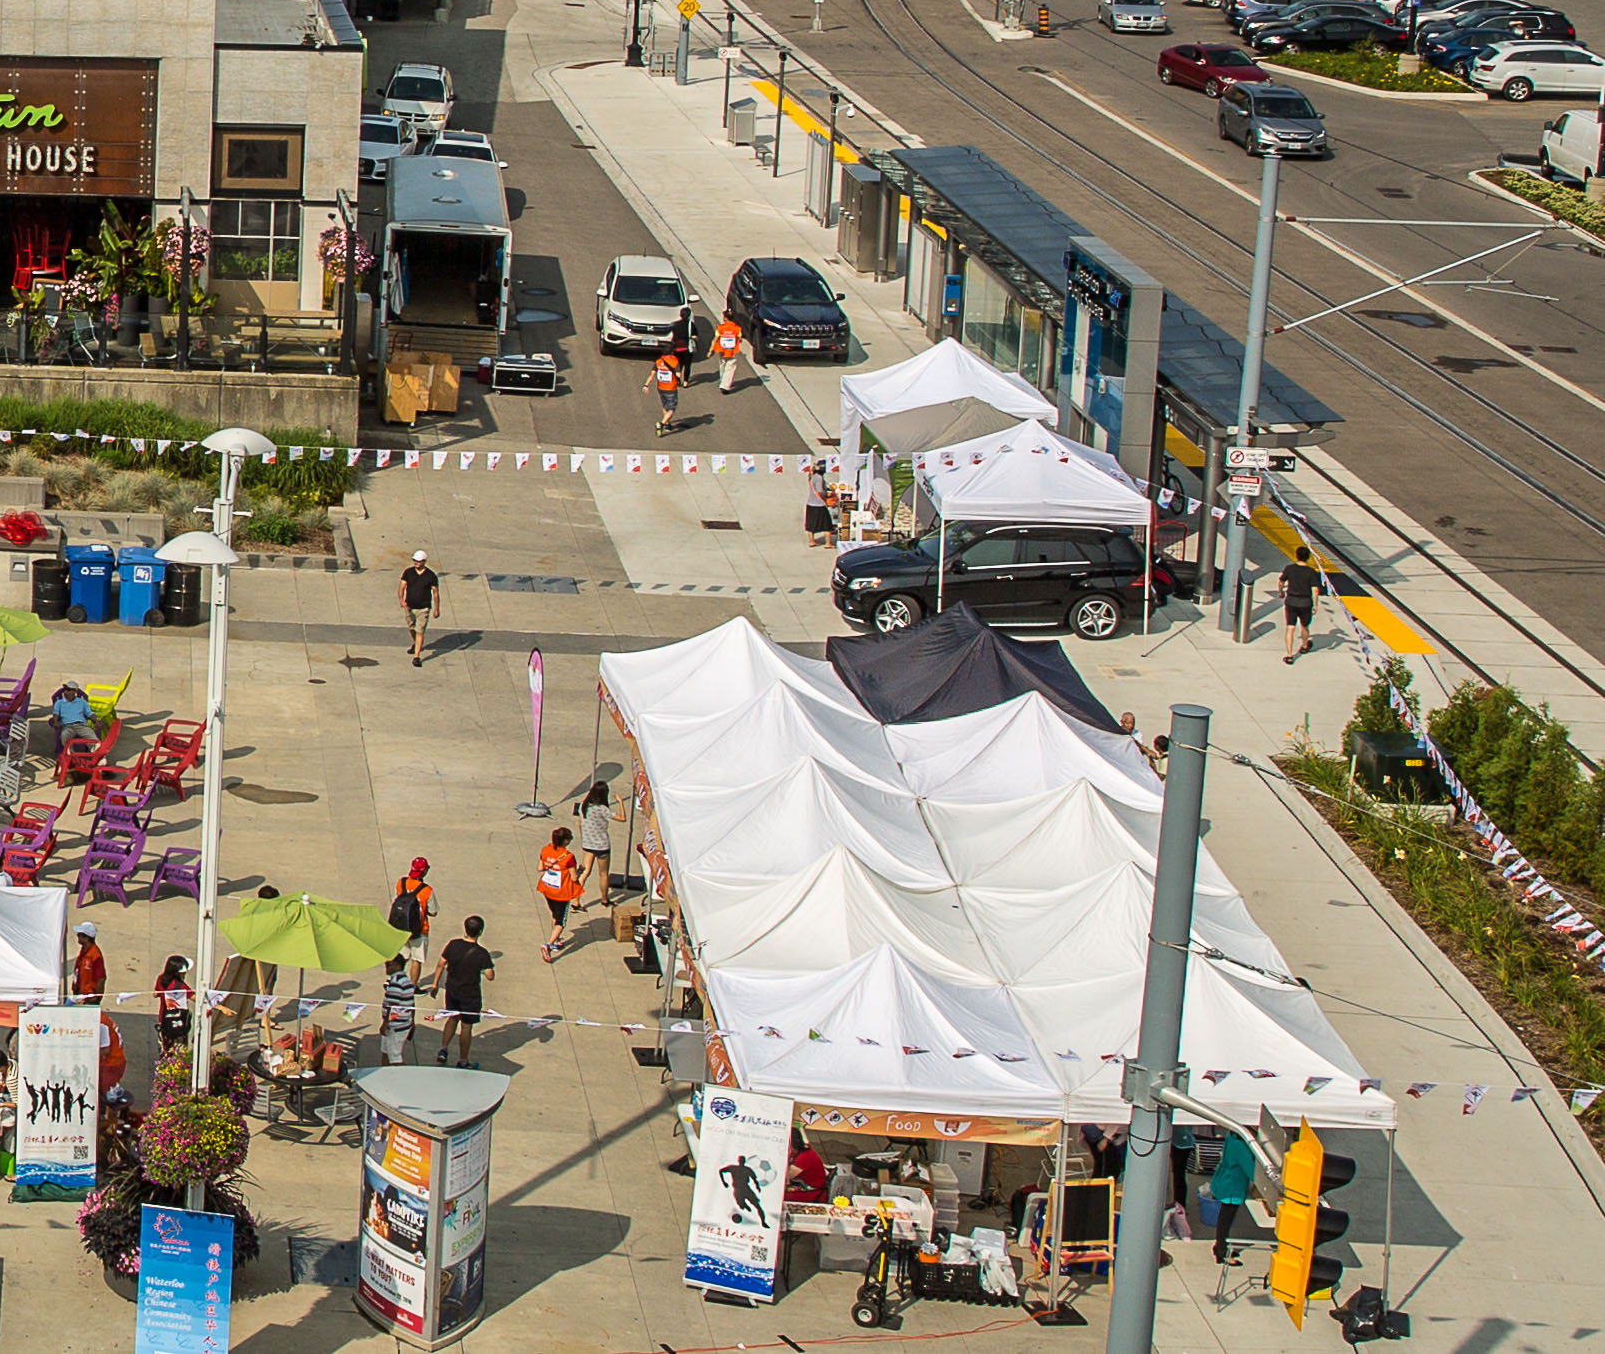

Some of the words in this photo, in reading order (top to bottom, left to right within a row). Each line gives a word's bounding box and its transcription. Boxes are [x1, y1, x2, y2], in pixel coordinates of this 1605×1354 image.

[683, 1, 696, 12] 20
[6, 143, 96, 173] HOUSE
[386, 1198, 426, 1228] CAMPFIRE
[370, 1251, 385, 1268] WHAT
[385, 1264, 416, 1287] MATTERS
[145, 1276, 185, 1288] Waterloo
[145, 1286, 174, 1298] Region
[144, 1296, 177, 1308] Chinese
[143, 1308, 192, 1321] Community
[144, 1319, 192, 1331] Association
